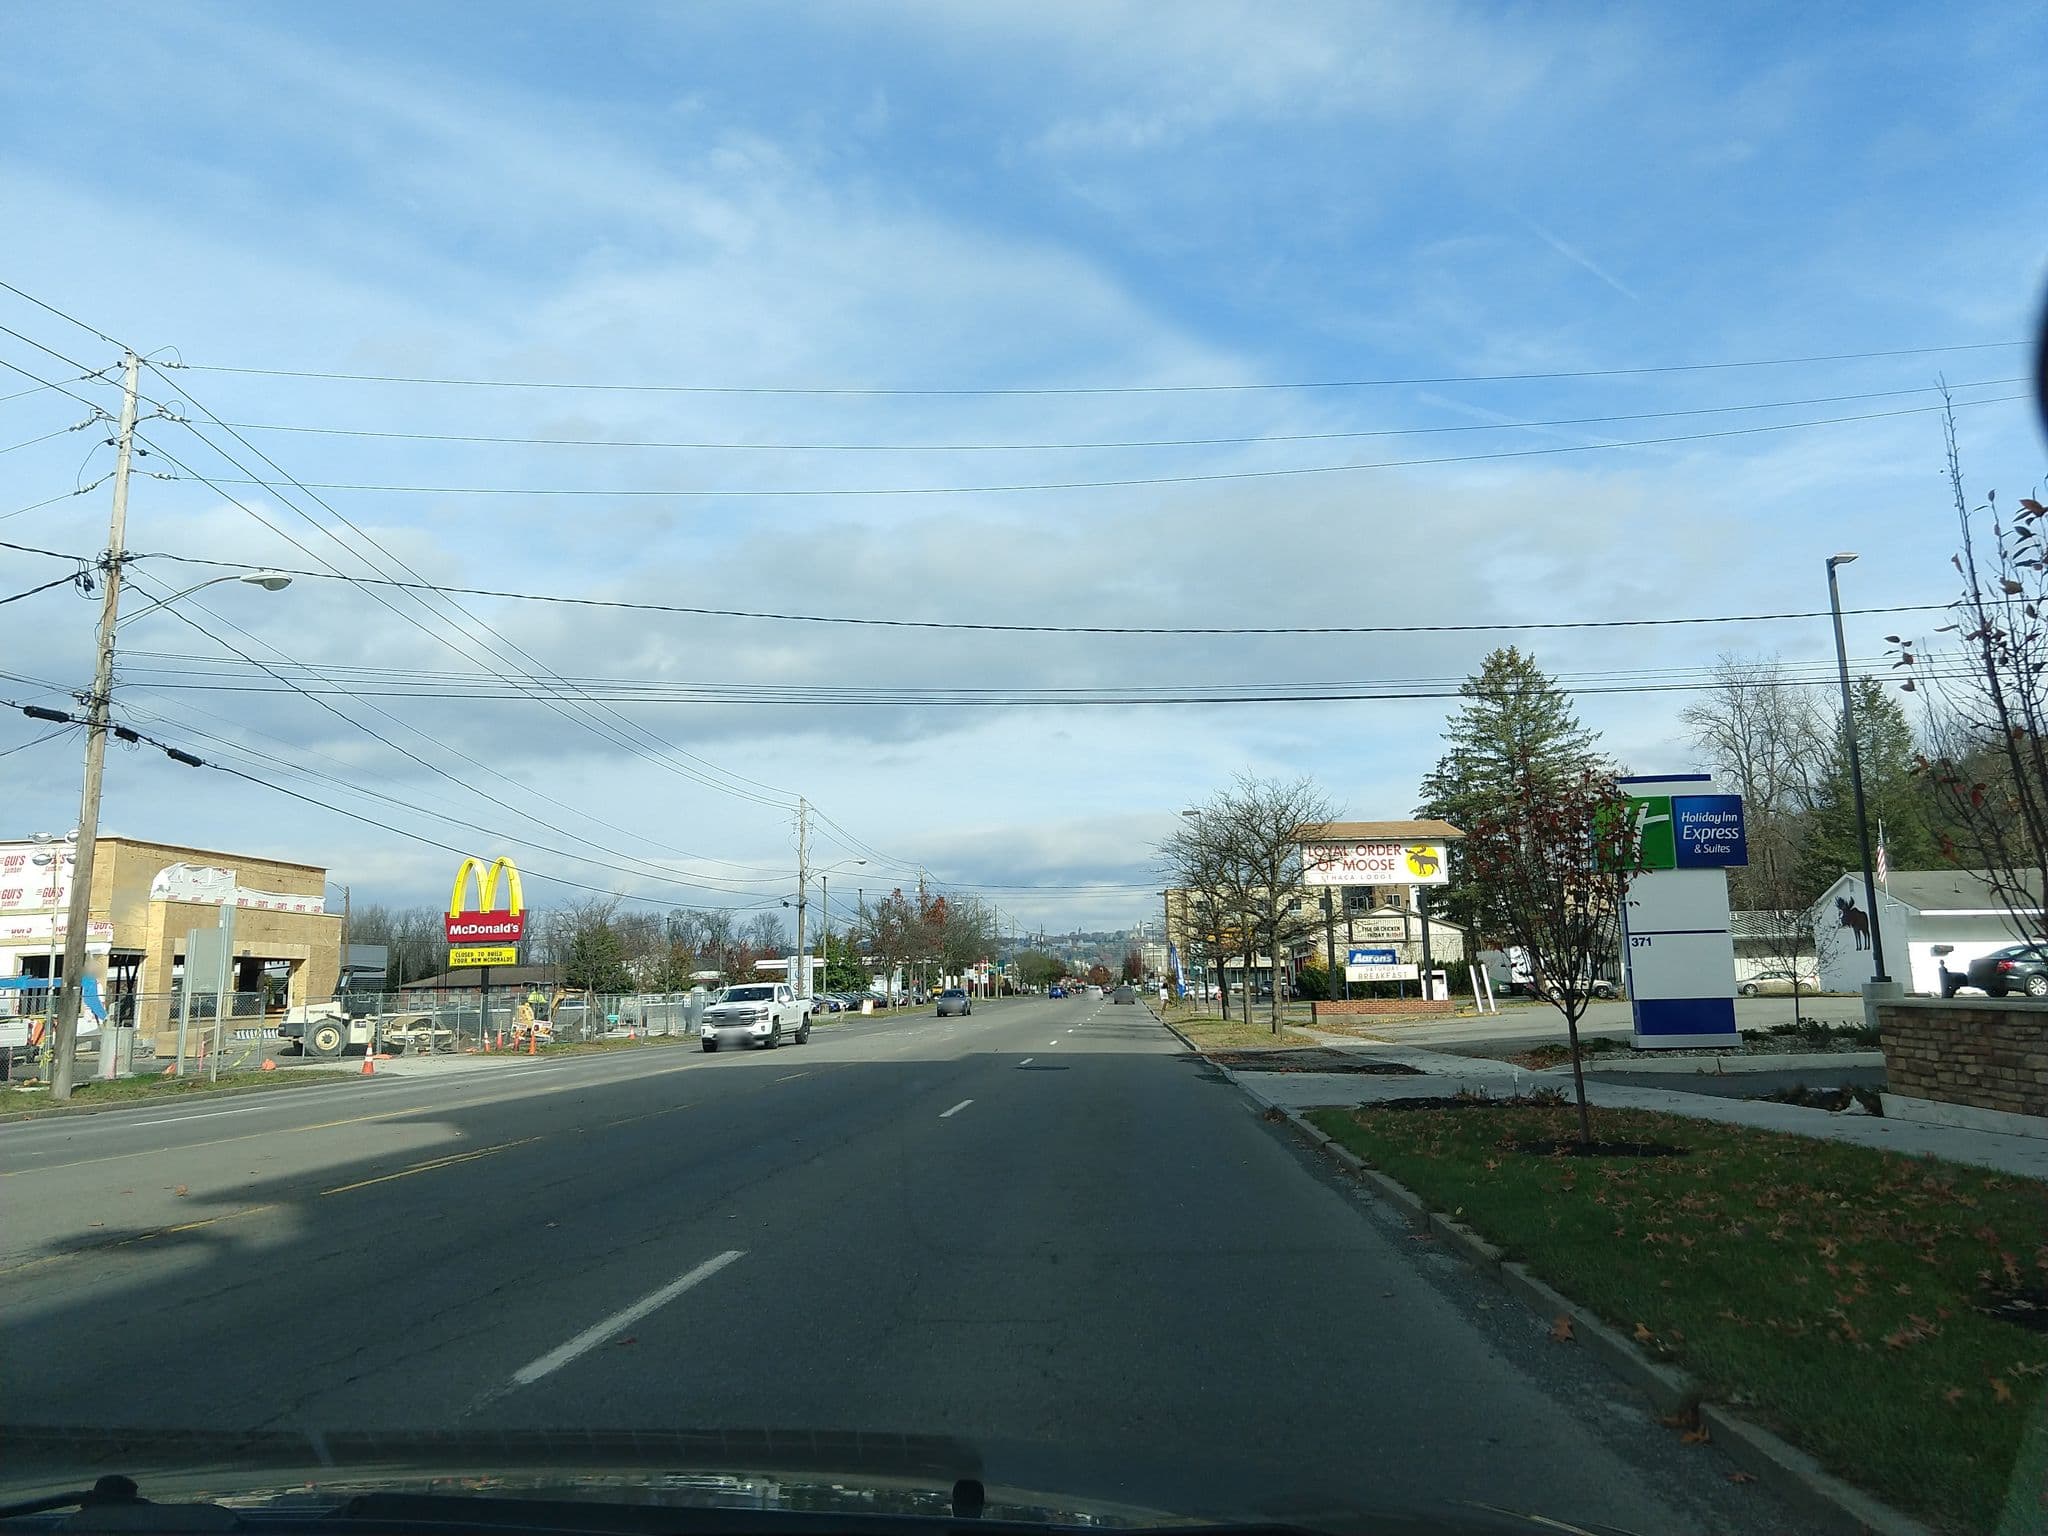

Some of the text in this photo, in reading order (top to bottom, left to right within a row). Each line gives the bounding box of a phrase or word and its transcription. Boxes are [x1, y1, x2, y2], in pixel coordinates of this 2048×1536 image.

[1681, 811, 1738, 825] Holiday Inn
[1683, 825, 1739, 843] Express
[1308, 844, 1402, 857] LOYAL ORDER
[1694, 844, 1731, 854] & Suites
[1317, 859, 1396, 872] OF MOOSE
[449, 923, 520, 935] McDonald's
[1631, 937, 1652, 947] 371
[1352, 953, 1392, 963] Aaron's
[1358, 972, 1407, 980] BREAKFAST
